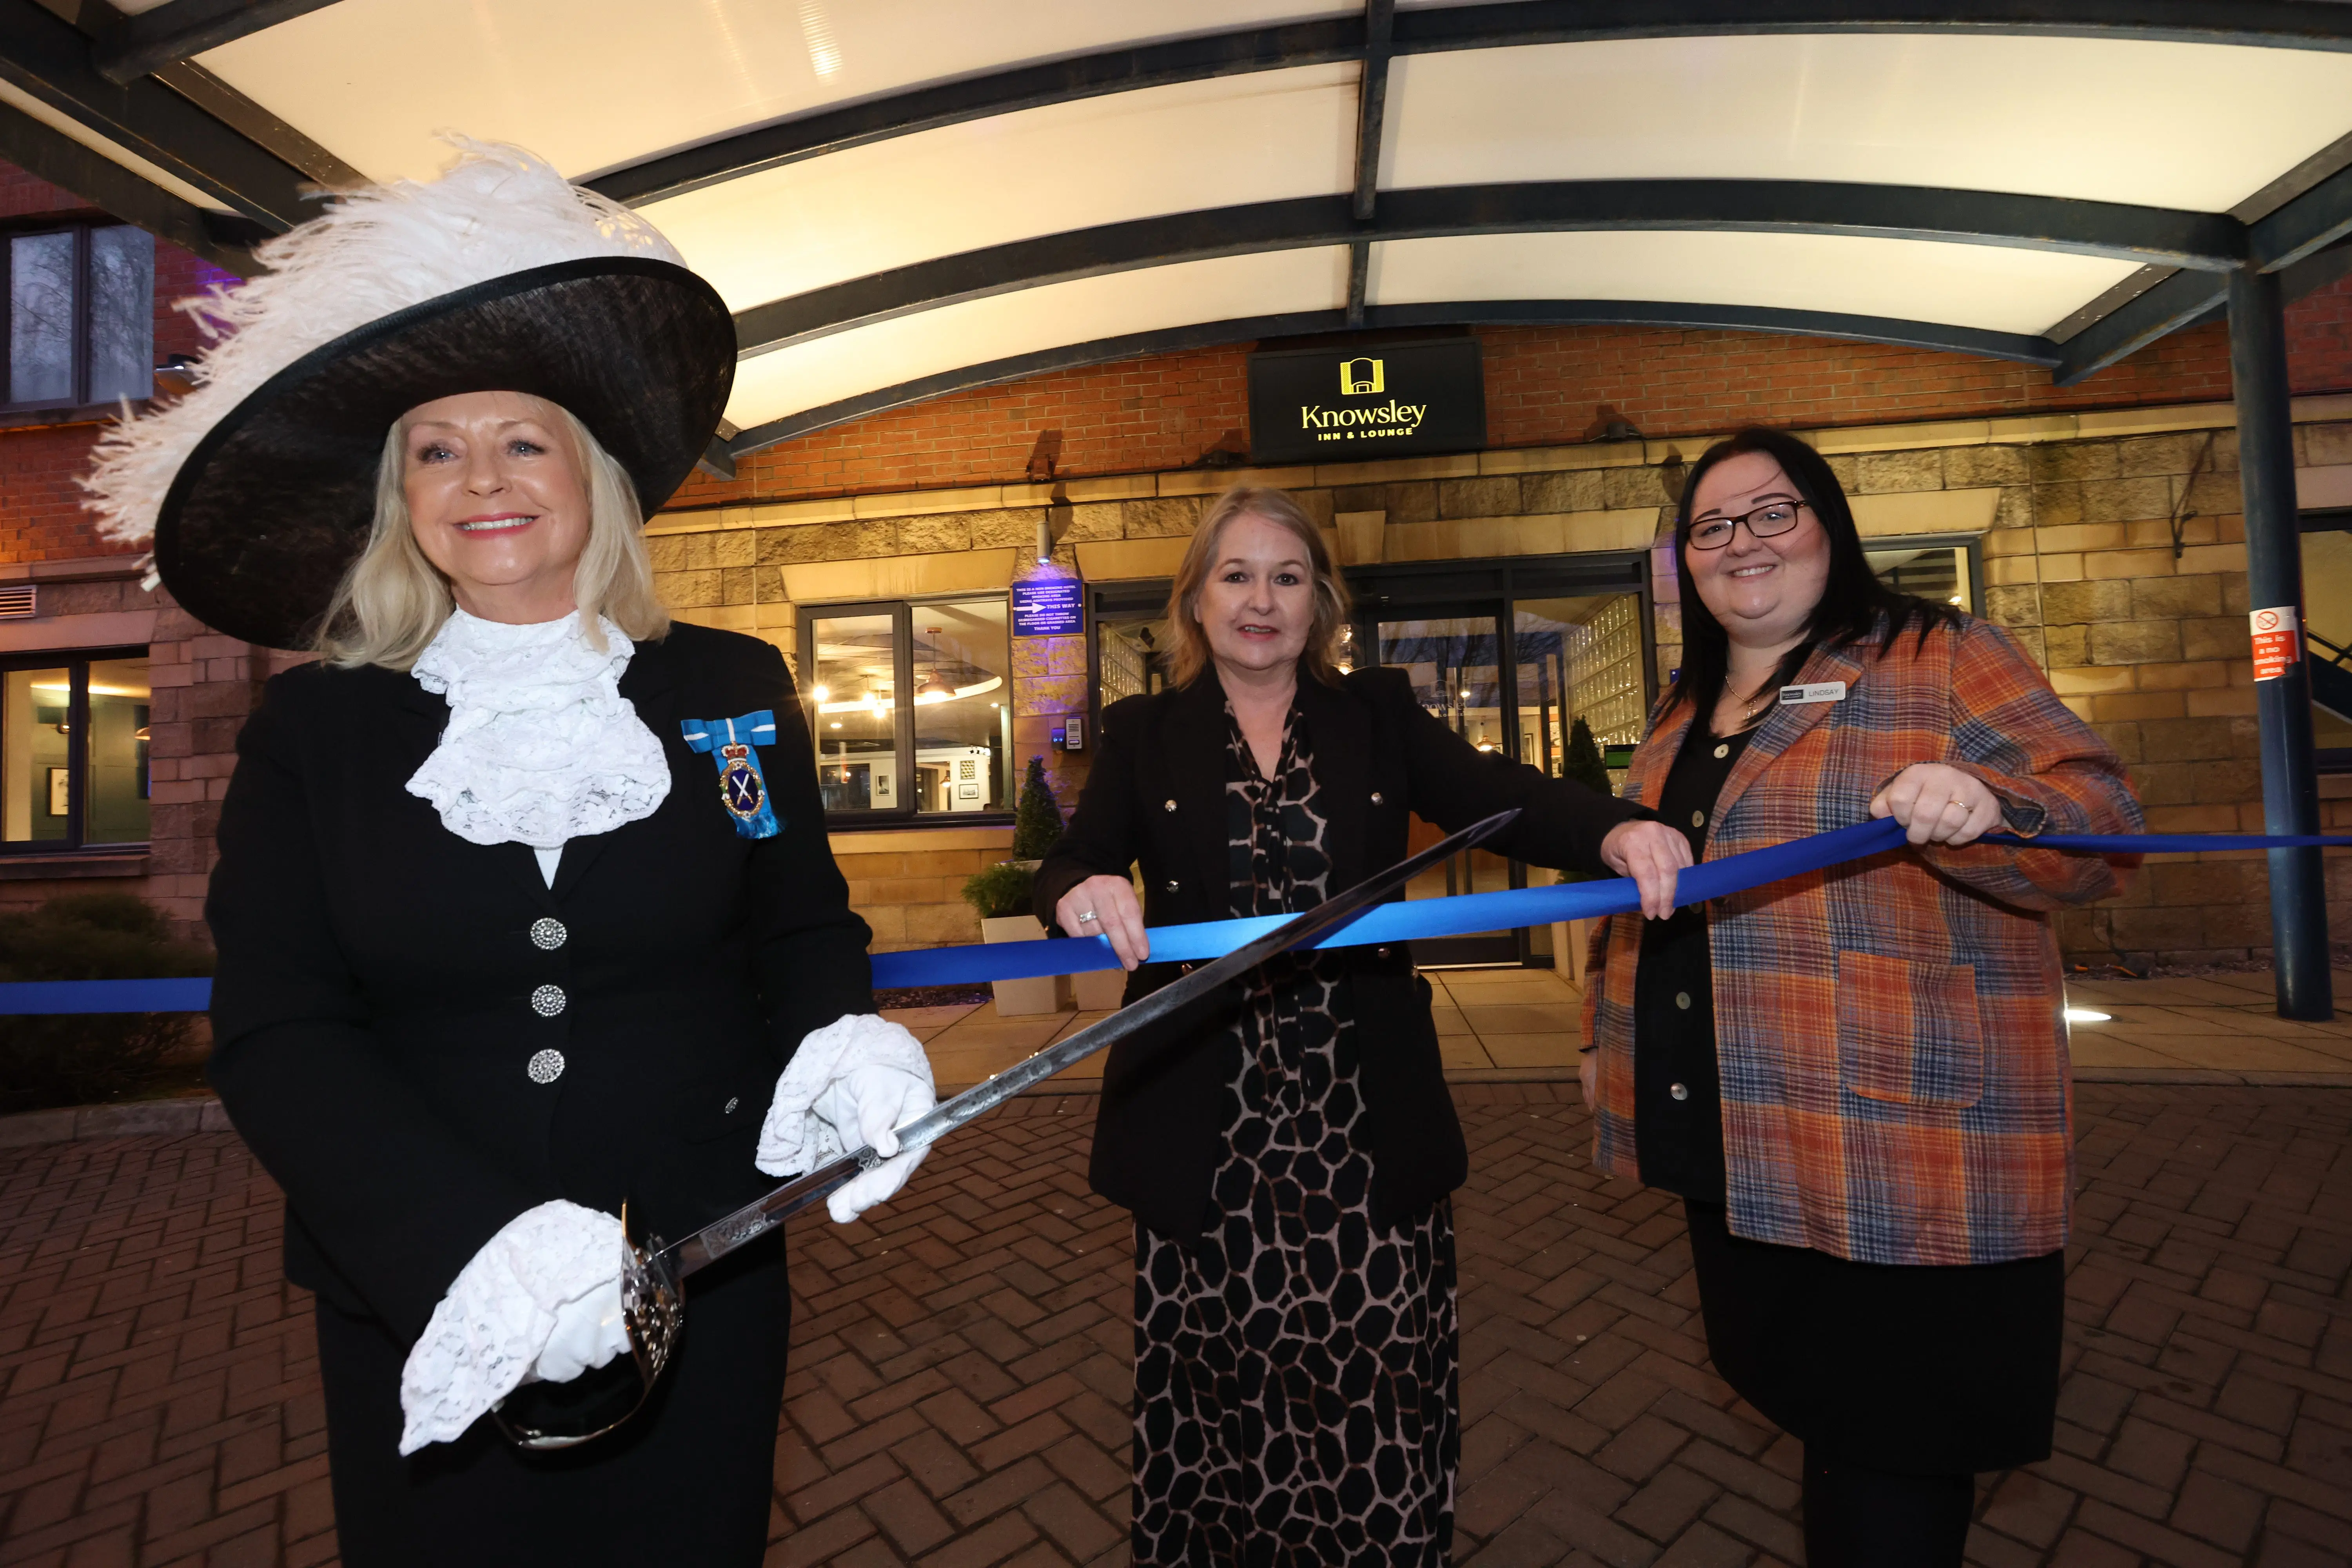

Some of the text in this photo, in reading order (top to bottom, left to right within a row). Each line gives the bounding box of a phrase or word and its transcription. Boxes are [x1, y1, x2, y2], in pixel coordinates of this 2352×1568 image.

[1301, 399, 1427, 429] Knowsley
[1318, 428, 1413, 441] INN & LOUNGE
[2254, 636, 2273, 645] This
[2254, 655, 2292, 665] smoking
